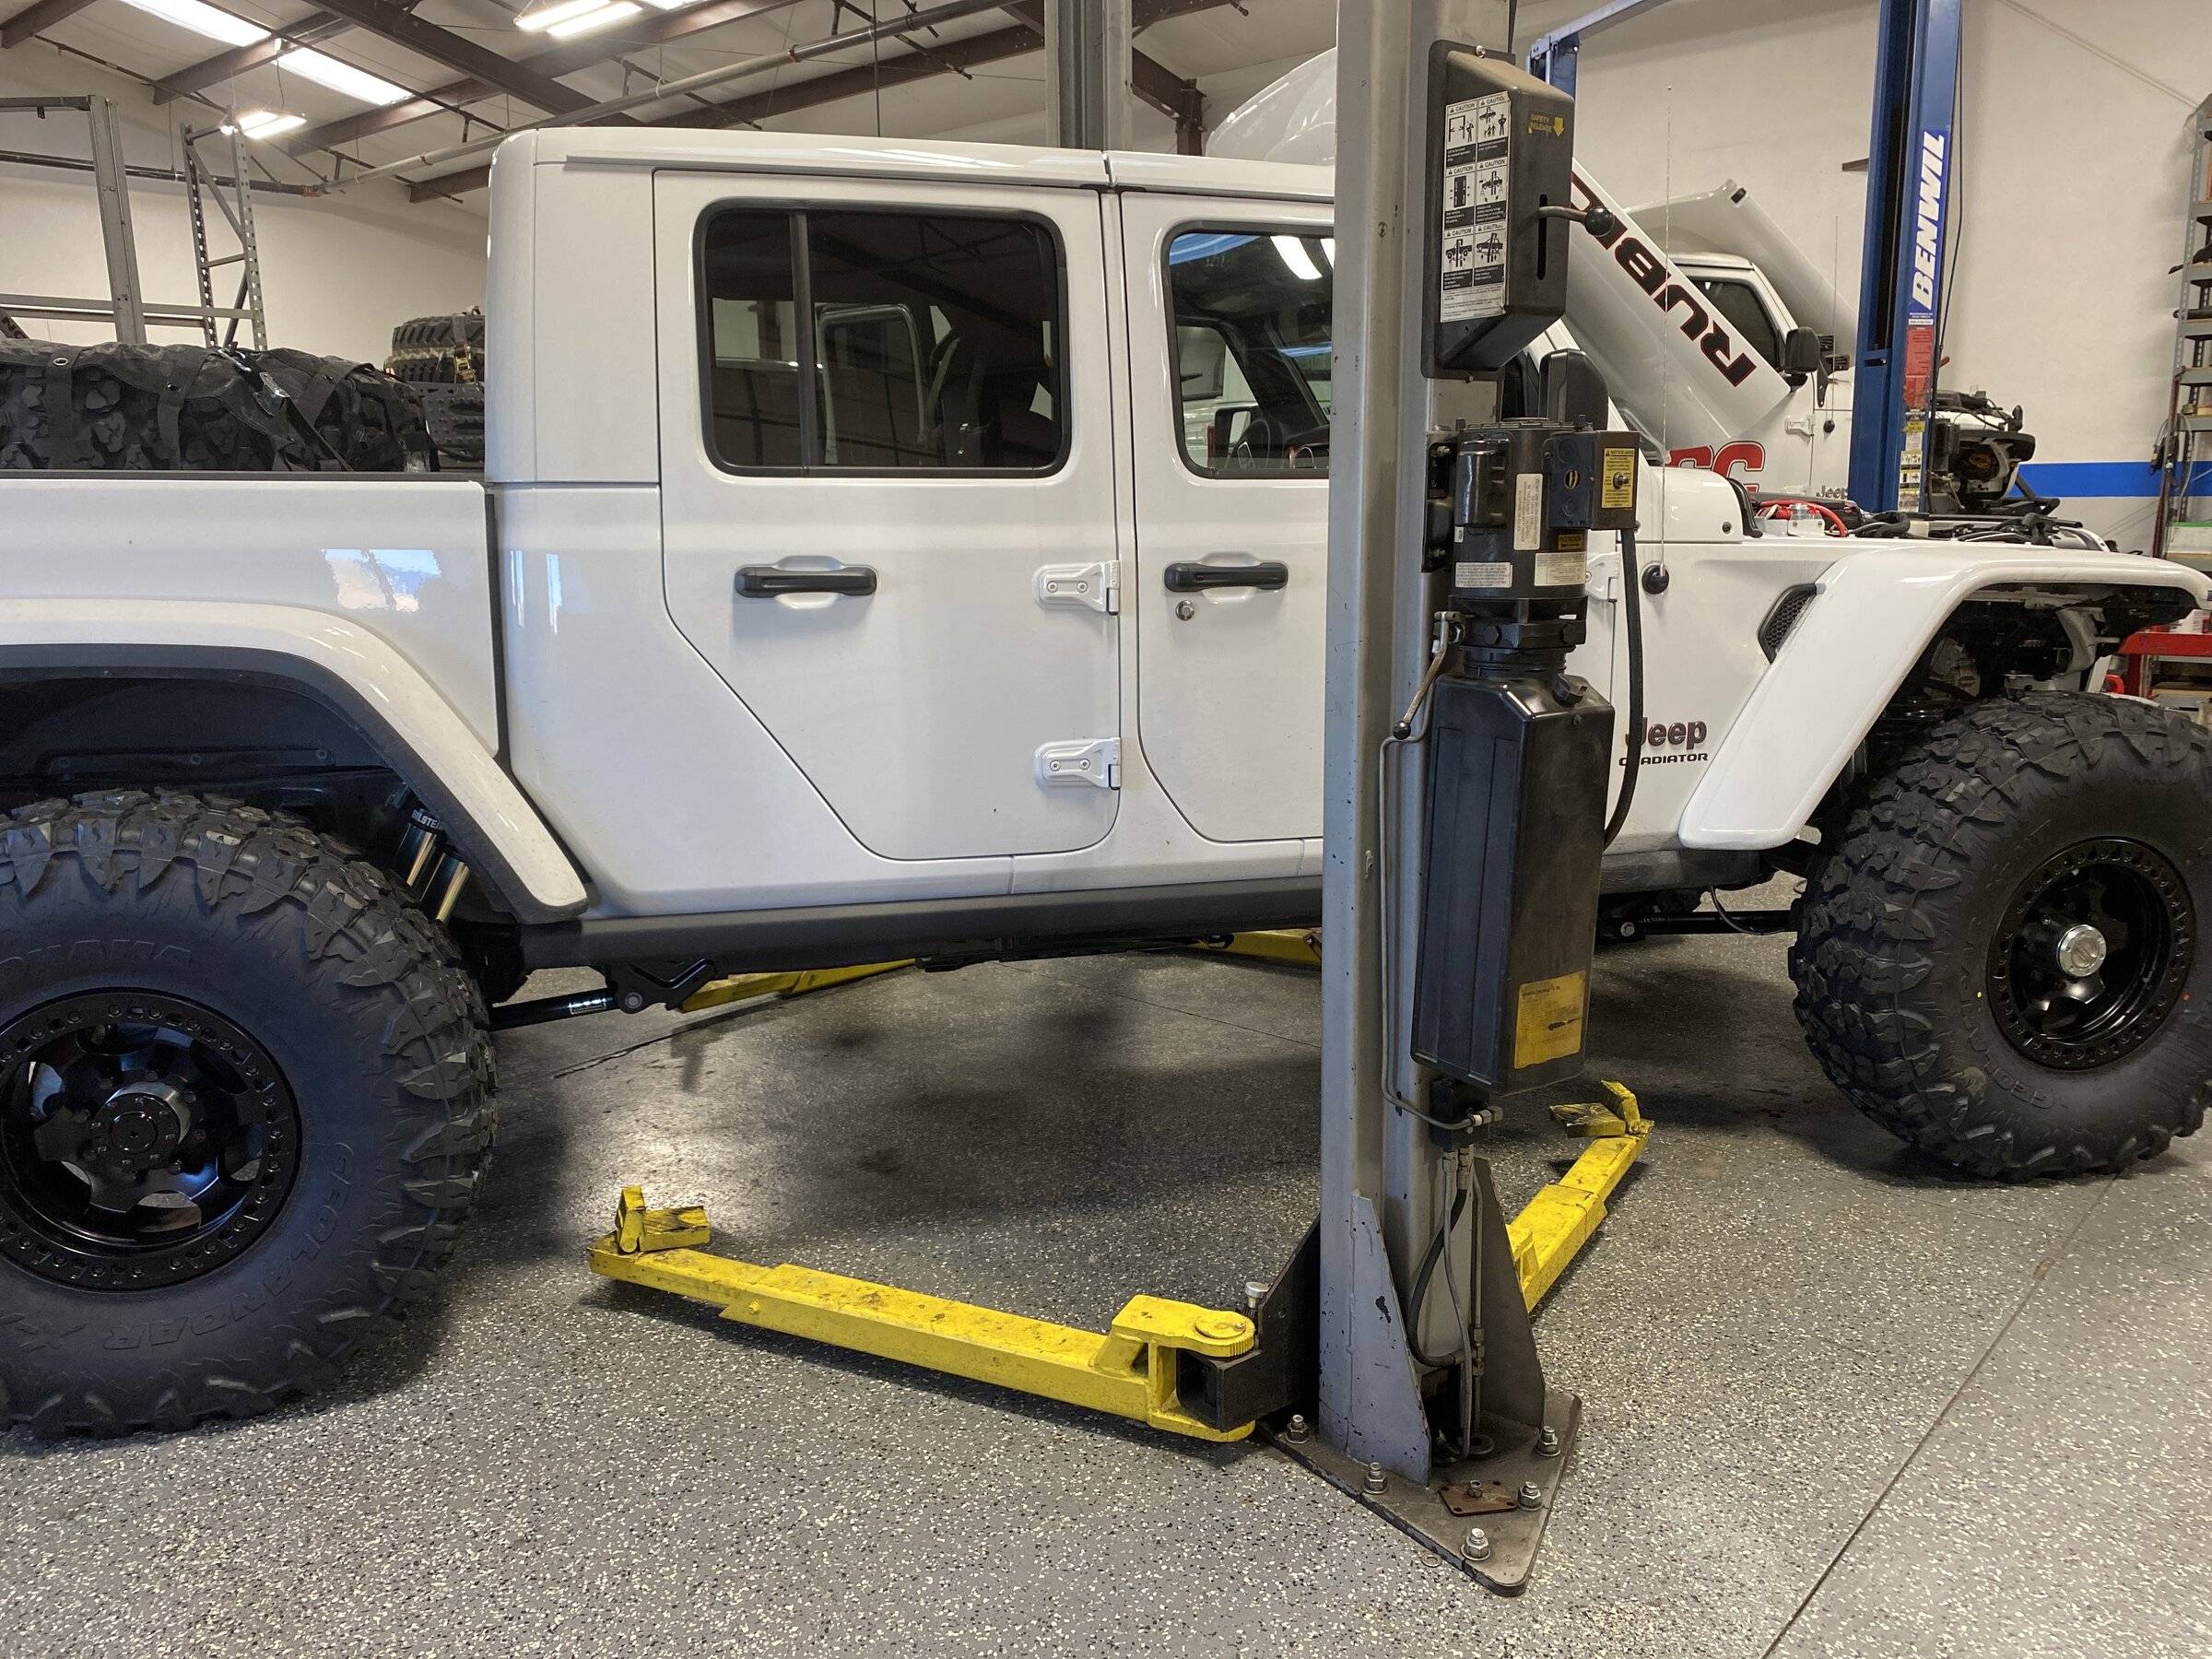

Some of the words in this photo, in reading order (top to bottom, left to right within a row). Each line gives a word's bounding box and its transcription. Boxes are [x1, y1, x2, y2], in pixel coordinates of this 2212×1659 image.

[1487, 96, 1505, 104] CAUTIO
[1456, 102, 1475, 111] CAUTION
[1485, 159, 1505, 168] CAUTION
[1453, 165, 1473, 174] CAUTION
[1912, 131, 1945, 310] BENWIL
[1452, 228, 1472, 237] CAUTION
[1816, 485, 1849, 500] Jeep
[1618, 753, 1708, 766] GADIATOR
[411, 809, 443, 830] BILSTE
